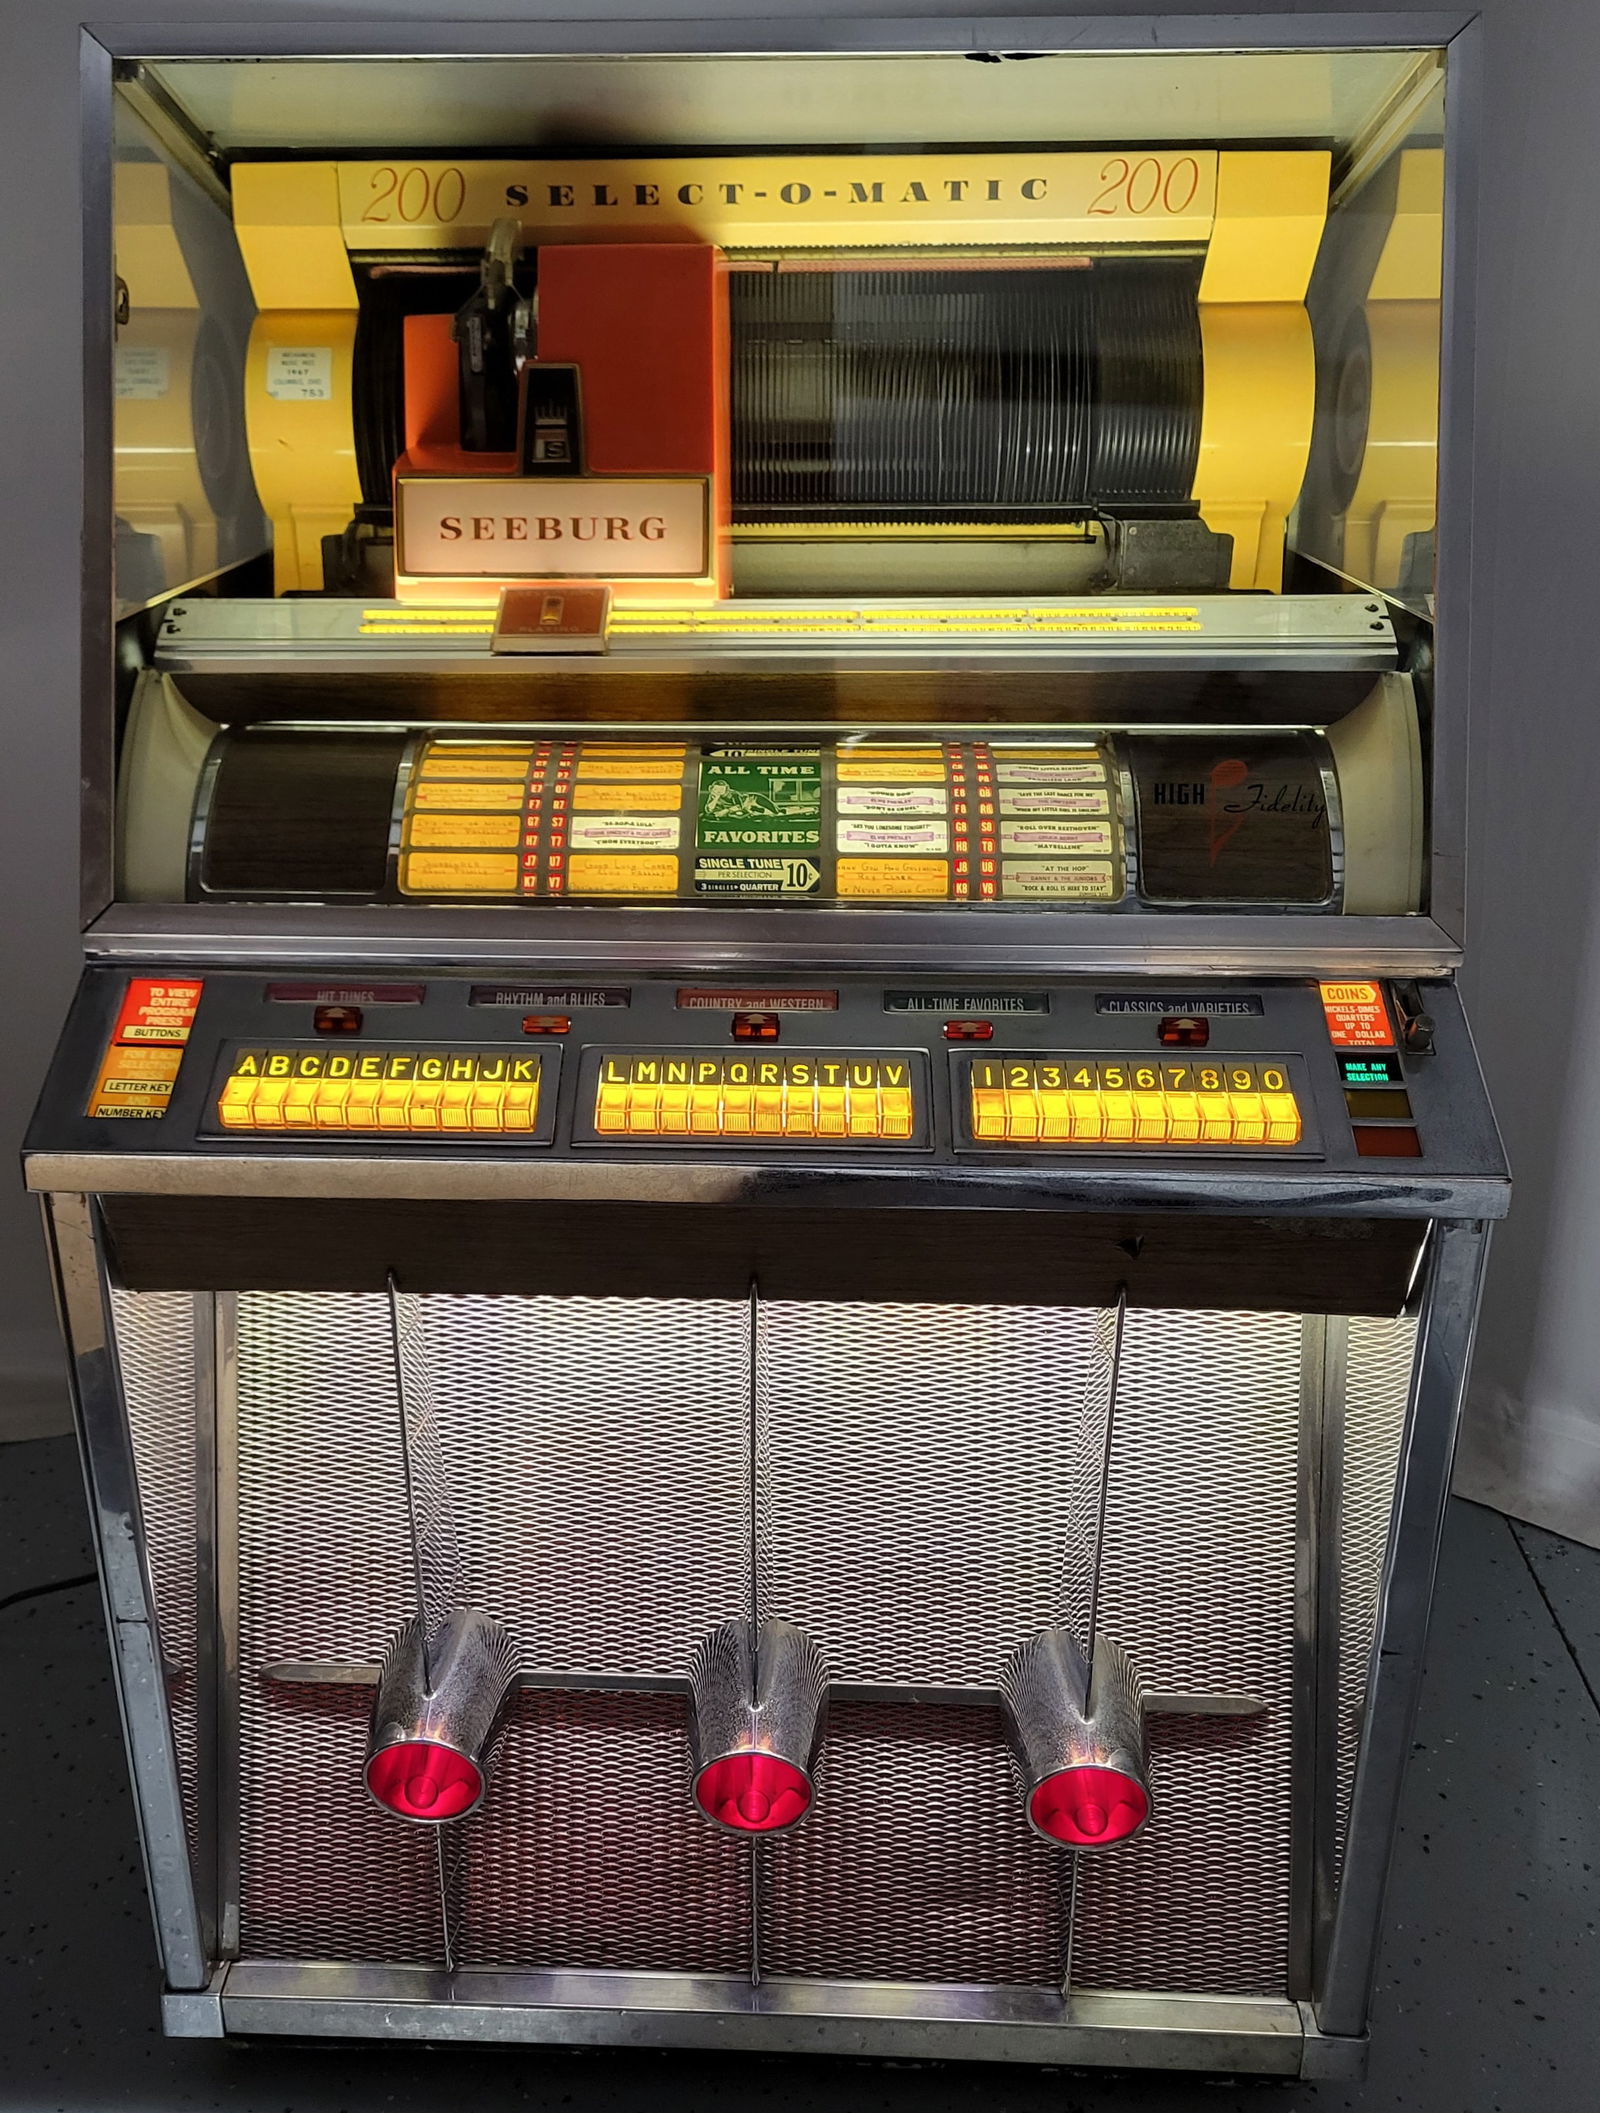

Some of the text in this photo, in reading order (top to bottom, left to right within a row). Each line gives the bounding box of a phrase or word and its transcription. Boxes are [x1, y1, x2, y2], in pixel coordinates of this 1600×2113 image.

[362, 157, 1199, 223] 200 SELECT-O-MATIC 200
[440, 516, 668, 541] SEEBURG
[707, 766, 815, 775] ALL TIME
[531, 784, 543, 793] E7
[954, 788, 966, 797] E8
[528, 799, 541, 809] F7
[553, 800, 565, 809] R7
[955, 804, 967, 814] F8
[1154, 783, 1326, 829] HIGH Fidelity
[527, 816, 540, 826] G7
[552, 816, 563, 827] S7
[955, 821, 967, 832] G8
[981, 821, 993, 832] S8
[526, 835, 538, 846] H7
[551, 835, 562, 846] T7
[704, 830, 820, 843] FAVORITES
[956, 841, 968, 852] H8
[982, 841, 993, 852] T8
[525, 855, 537, 866] J7
[549, 855, 561, 866] U7
[699, 858, 782, 869] SINGLE TUNE
[956, 861, 967, 873] J8
[982, 861, 993, 873] U8
[524, 876, 536, 887] K7
[549, 877, 561, 888] V7
[956, 883, 968, 894] K8
[982, 883, 993, 894] V8
[150, 987, 198, 998] TO VIEW
[316, 990, 375, 1001] HIT TUNES
[1327, 987, 1369, 1000] COINS
[150, 997, 191, 1007] ENTIRE
[496, 992, 606, 1006] RHYTHM and BLUES
[689, 997, 824, 1009] COUNTRY and WESTERN
[907, 998, 1025, 1011] ALL-TIME FAVORITES
[1109, 1001, 1249, 1014] CLASSICS and VARIETIES
[1325, 1005, 1381, 1014] NICKELS-DIMES
[145, 1016, 183, 1025] PRESS
[1336, 1013, 1375, 1022] QUARTERS
[1344, 1022, 1370, 1030] UP TO
[134, 1028, 181, 1038] BUTTONS
[1331, 1030, 1386, 1039] ONE DOLLAR
[1345, 1063, 1387, 1071] MAKE ANY
[1346, 1073, 1389, 1082] SELECTION
[109, 1082, 171, 1092] LETTER KEY
[97, 1108, 144, 1118] NUMBER
